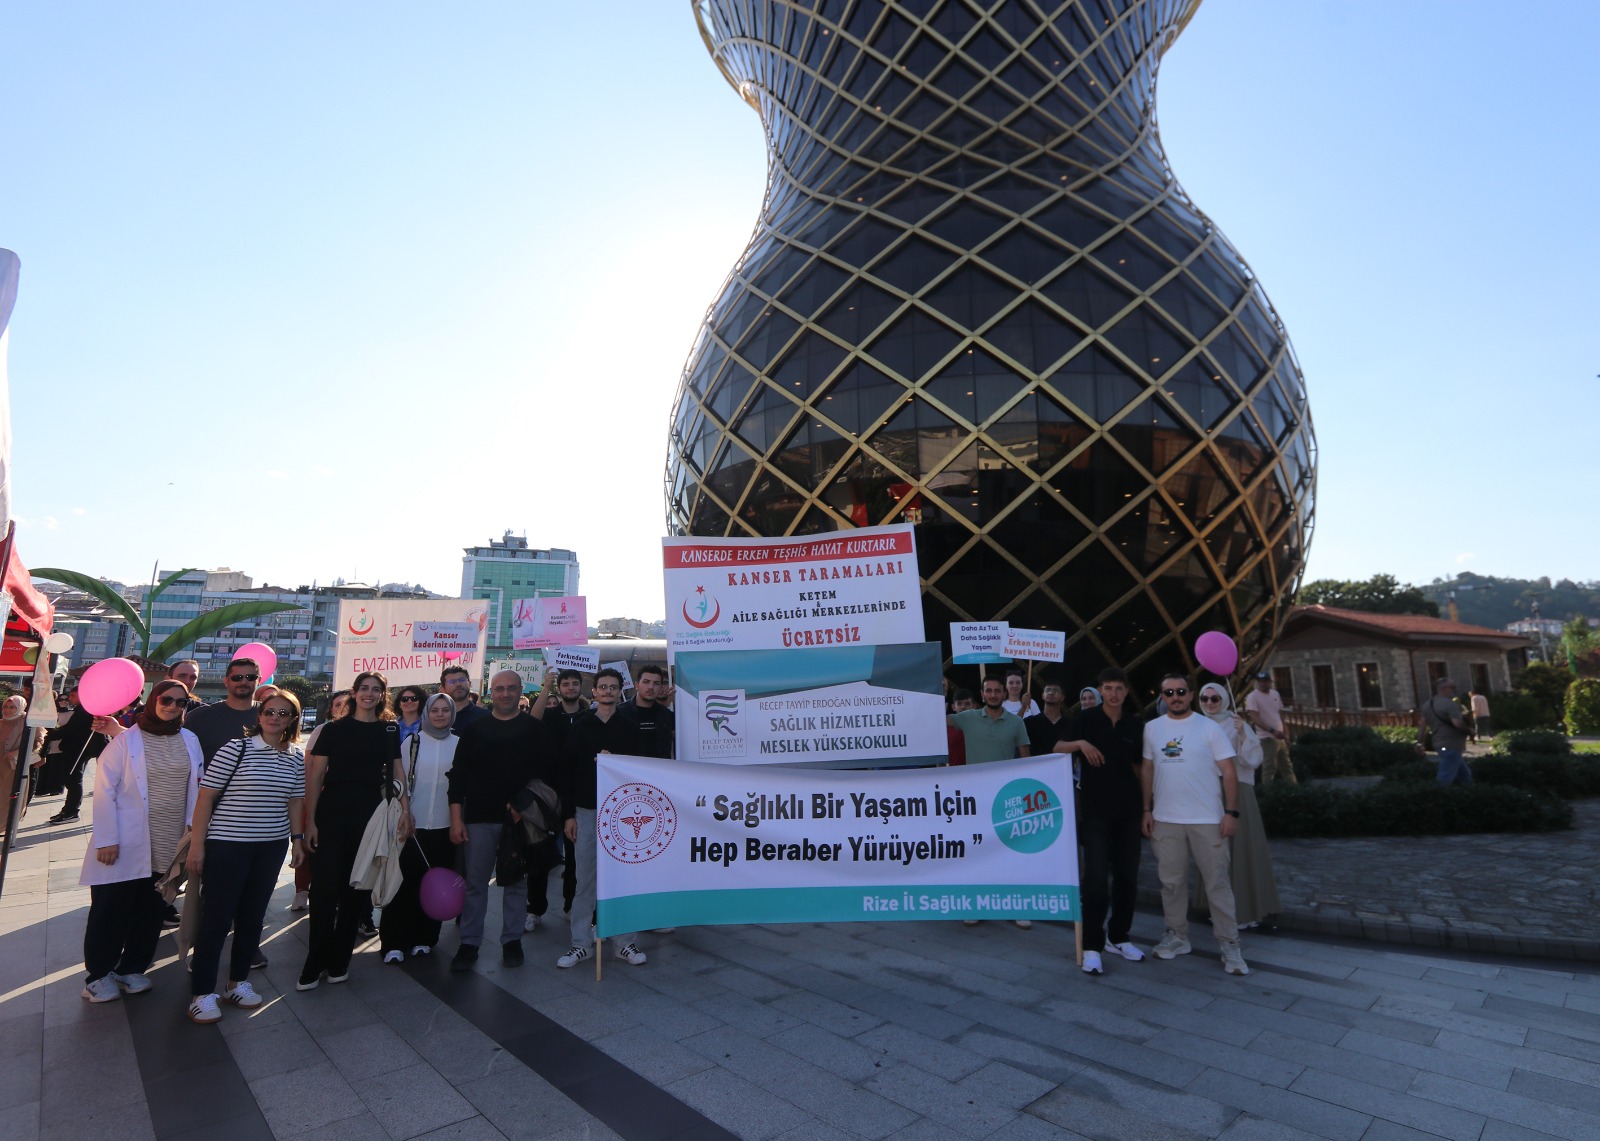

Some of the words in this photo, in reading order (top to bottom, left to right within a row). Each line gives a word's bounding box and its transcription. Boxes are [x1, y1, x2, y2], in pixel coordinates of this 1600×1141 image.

[680, 549, 733, 563] KANSERDE
[737, 549, 769, 561] ERKEN
[773, 545, 808, 561] TEŞHİS
[811, 542, 844, 557] HAYAT
[846, 538, 897, 554] KURTARIR
[728, 570, 792, 587] KANSER
[798, 561, 904, 581] TARAMALARI
[799, 590, 837, 601] KETEM
[732, 611, 759, 623] AİLE
[760, 607, 808, 621] SAĞLIĞI
[812, 600, 907, 617] MERKEZLERİNDE
[391, 623, 413, 638] 1-7
[433, 631, 459, 639] Kanser
[782, 623, 861, 647] ÜCRETSİZ
[413, 641, 448, 649] kaderiniz
[449, 641, 477, 649] olmasın
[1008, 638, 1031, 646] Erken
[1032, 641, 1057, 649] teşhis
[557, 652, 590, 663] Farkındayız
[1004, 647, 1027, 656] hayat
[1027, 649, 1060, 659] kurtarır
[353, 654, 423, 673] EMZİRME
[515, 663, 539, 672] Durak
[571, 660, 597, 671] Yeneceğiz
[759, 701, 784, 711] RECEP
[786, 698, 810, 709] TAYYİP
[812, 696, 851, 708] ERDOĞAN
[853, 694, 905, 707] ÜNİVERSİTESİ
[770, 714, 816, 732] SAĞLIK
[820, 709, 896, 730] HİZMETLERİ
[760, 738, 810, 754] MESLEK
[813, 734, 908, 752] YÜKSEKOKULU
[712, 792, 804, 828] Sağlıklı
[812, 792, 845, 819] Bir
[849, 792, 928, 825] Yaşam
[934, 784, 977, 823] İçin
[1004, 796, 1022, 809] HER
[1022, 790, 1048, 814] 10
[1005, 807, 1023, 819] GÜN
[690, 836, 738, 867] Hep
[745, 837, 842, 862] Beraber
[847, 833, 965, 865] Yürüyelim
[863, 895, 899, 912] Rize
[903, 891, 915, 911] İl
[919, 895, 973, 914] Sağlık
[976, 894, 1070, 914] Müdürlüğü
